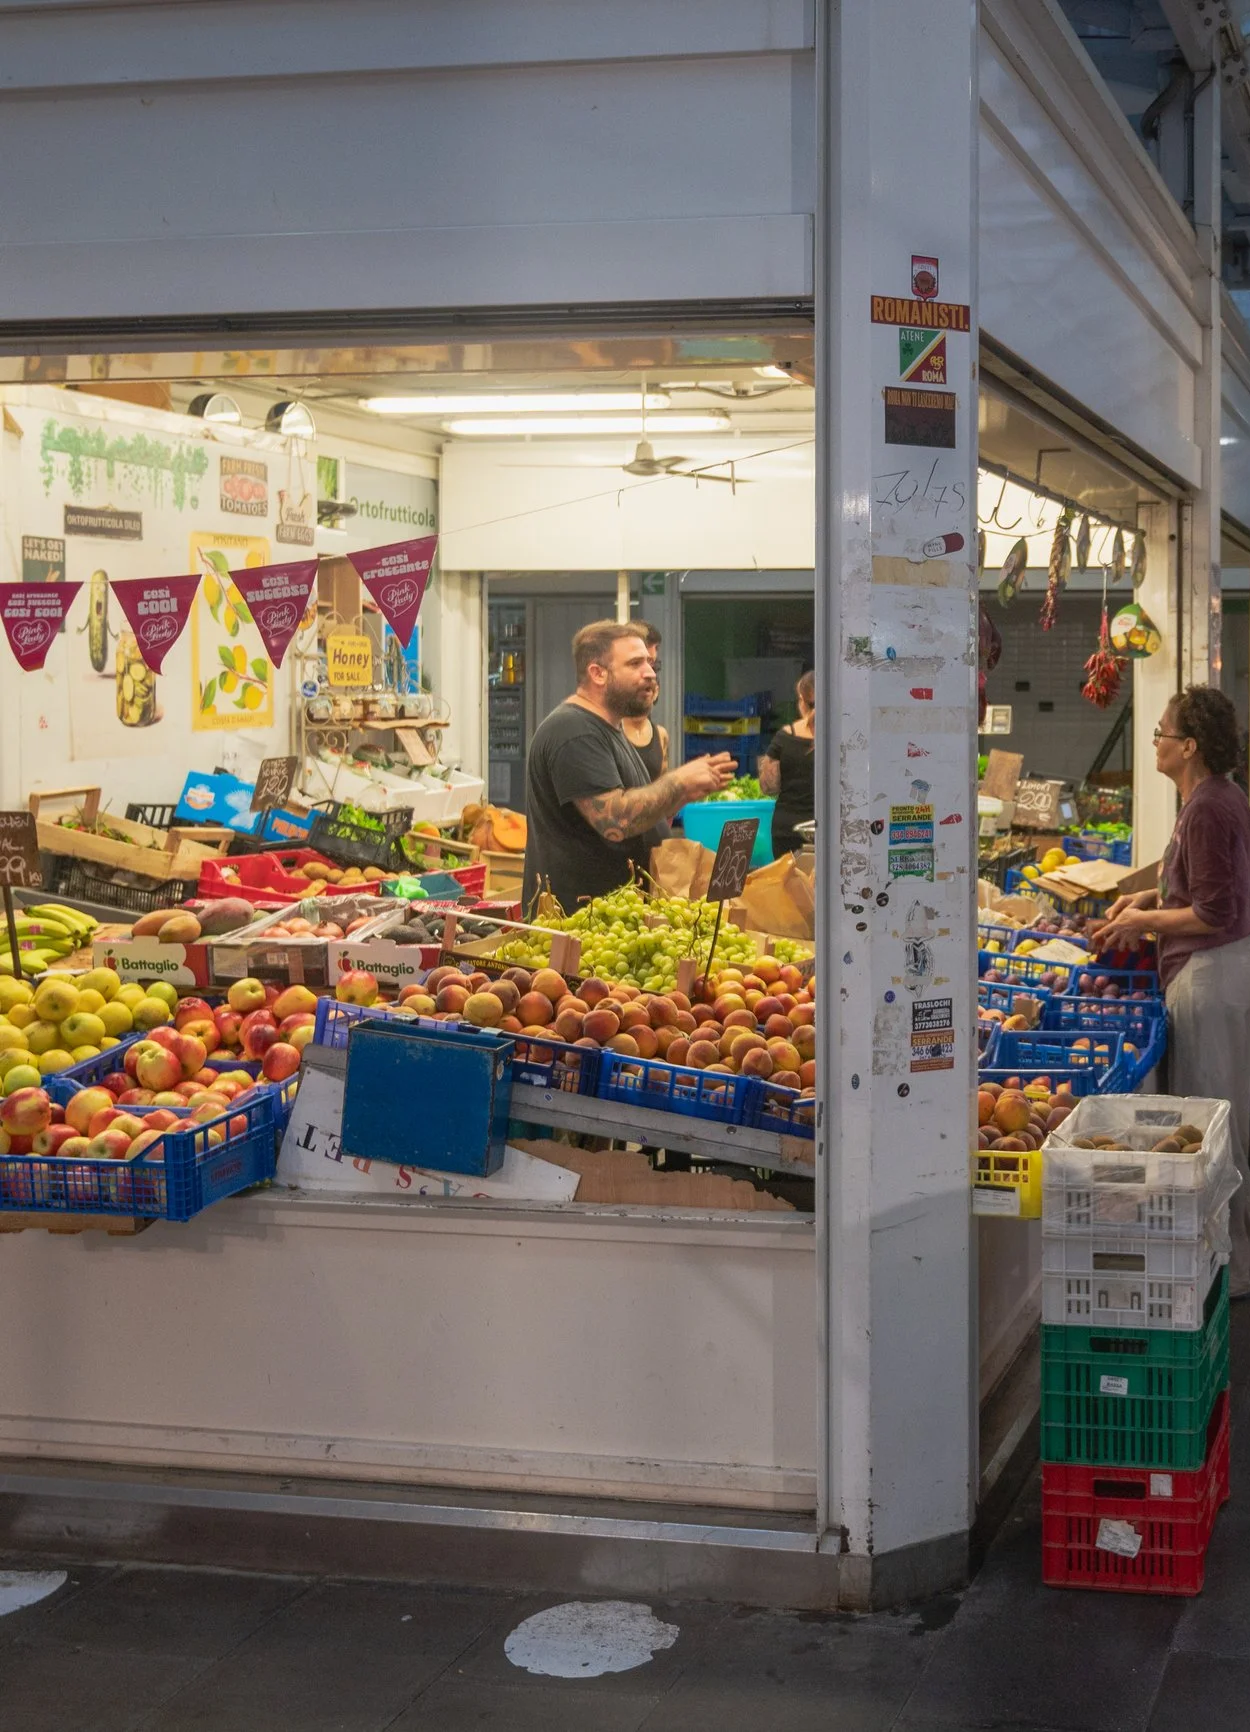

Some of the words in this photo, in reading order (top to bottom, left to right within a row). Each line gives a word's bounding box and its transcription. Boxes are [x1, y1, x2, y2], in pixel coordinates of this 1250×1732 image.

[873, 296, 969, 330] ROMANISTI.
[900, 331, 925, 343] ATENE
[922, 370, 945, 383] ROMA
[220, 497, 268, 516] TOMATOES
[23, 548, 64, 562] NAKED!
[387, 582, 410, 600] Pink
[392, 593, 414, 608] Lady
[266, 605, 290, 624] Pink
[146, 619, 170, 636] Pink
[270, 615, 293, 630] Lady
[18, 622, 43, 640] Pink
[149, 628, 172, 642] Lady
[20, 632, 45, 646] Lady
[333, 648, 370, 668] Honey
[334, 672, 345, 681] FOR
[346, 672, 361, 681] SALE
[915, 805, 931, 814] 24H
[892, 814, 932, 822] SERRANDE
[121, 958, 179, 974] Battaglio
[356, 960, 415, 977] Battaglio
[914, 999, 951, 1010] TRASLOCHI
[911, 1035, 953, 1046] SERRANDE
